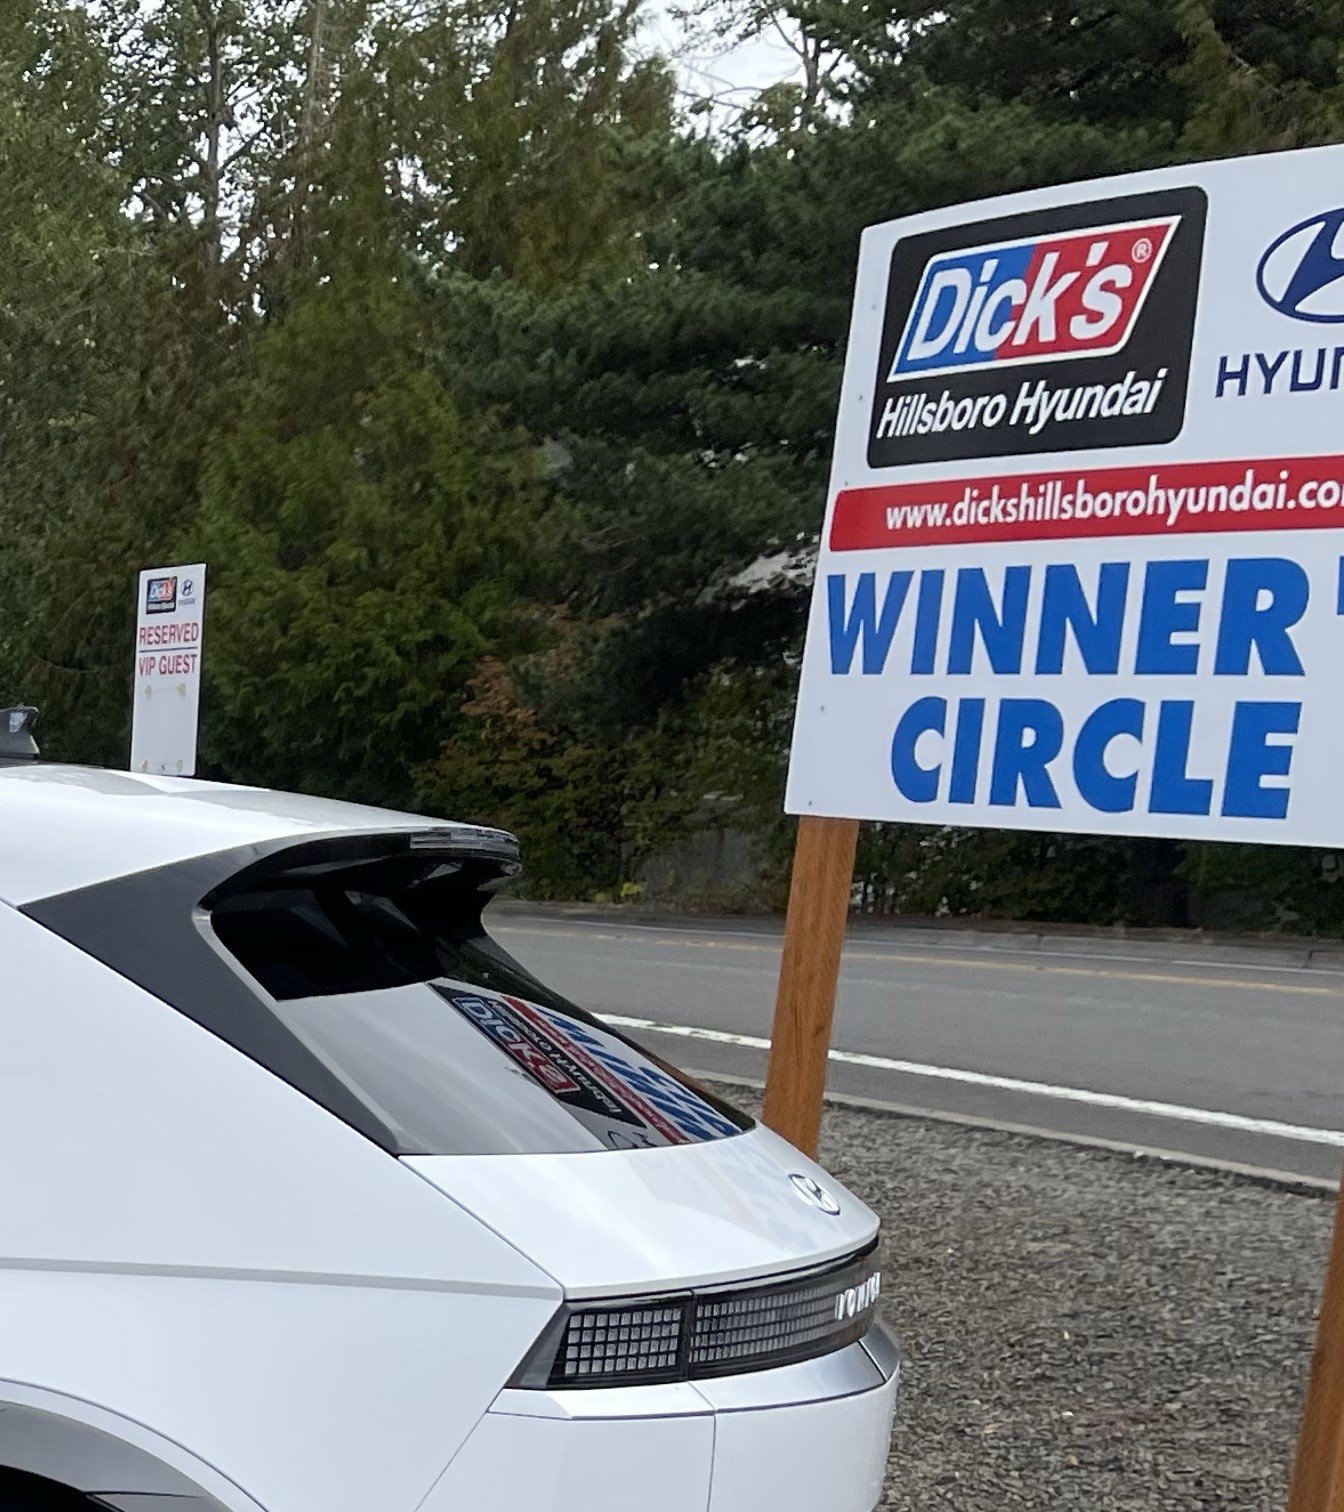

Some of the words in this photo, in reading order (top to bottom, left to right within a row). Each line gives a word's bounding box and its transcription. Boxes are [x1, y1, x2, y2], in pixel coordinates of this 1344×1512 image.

[876, 390, 1006, 440] Hillsboro
[1009, 368, 1168, 435] Hyundai
[885, 469, 1344, 530] www.dickshillsborohyundai.co
[139, 622, 199, 646] RESERVED
[138, 656, 156, 677] VIP
[158, 653, 198, 675] GUEST
[890, 695, 1303, 820] CIRCLE
